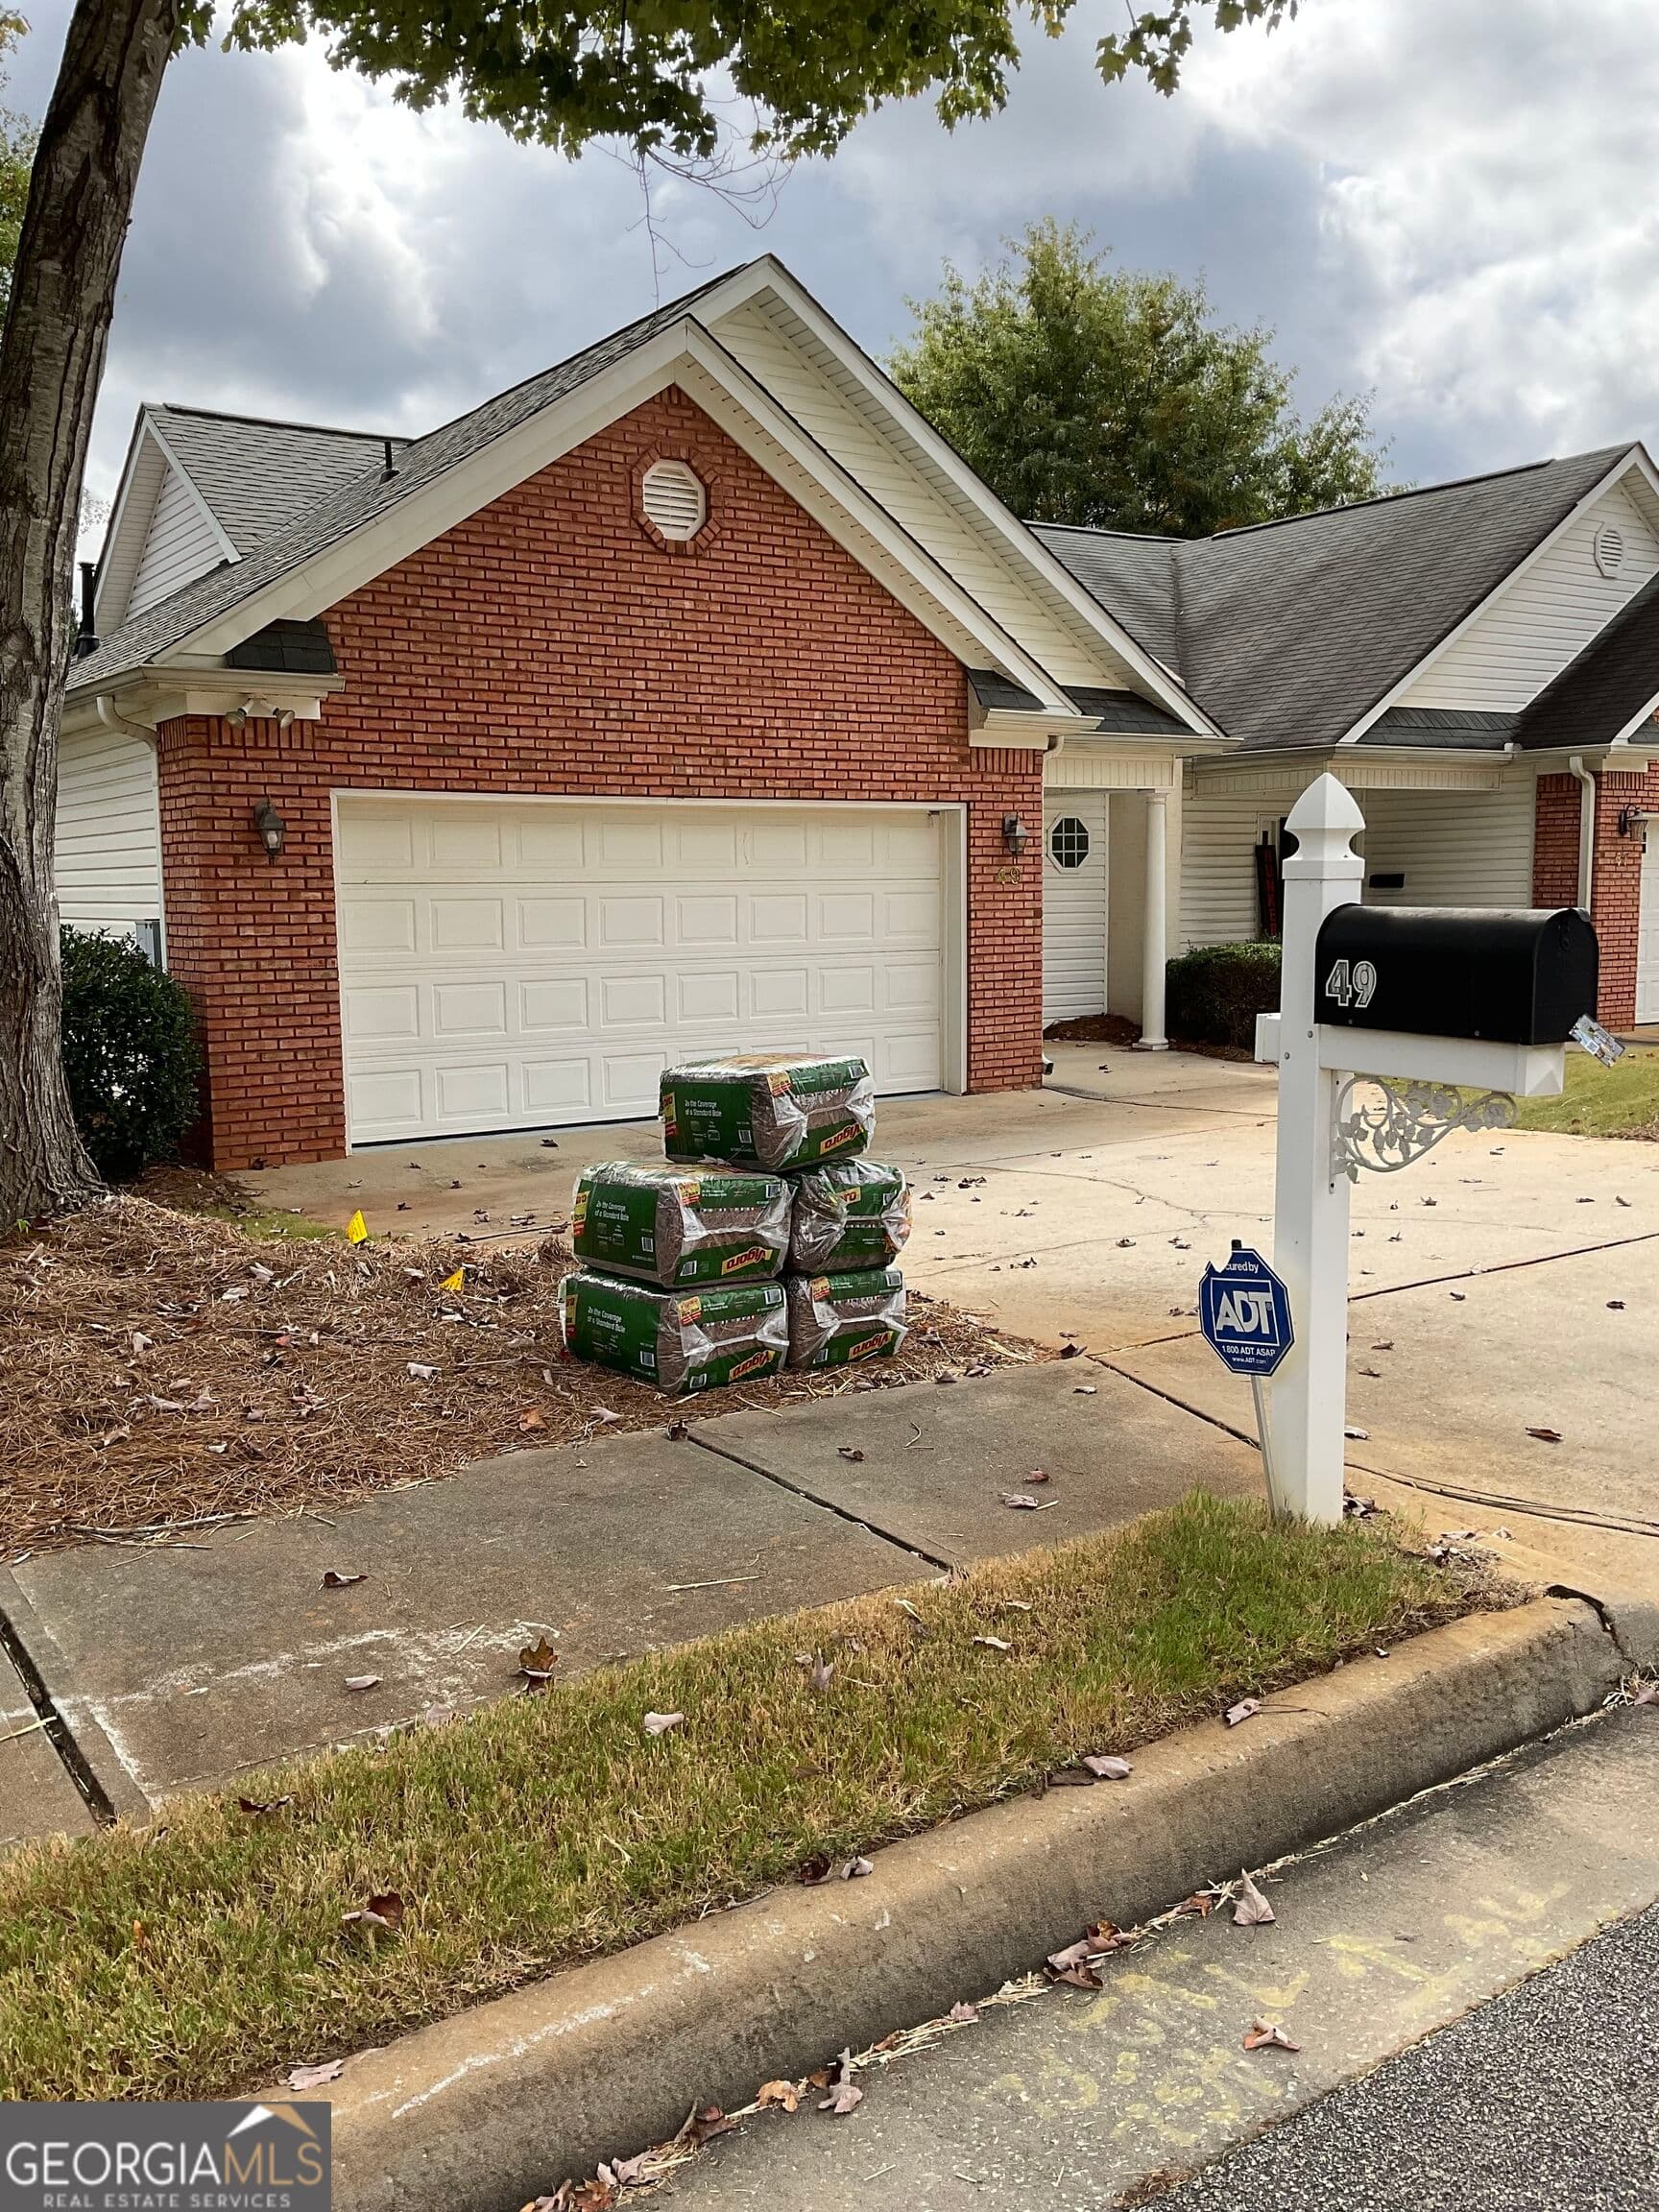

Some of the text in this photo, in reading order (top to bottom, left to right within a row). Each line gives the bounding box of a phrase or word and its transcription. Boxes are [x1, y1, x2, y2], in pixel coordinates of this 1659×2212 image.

[1325, 958, 1378, 1008] 49
[824, 1123, 862, 1149] Vigoro
[726, 1247, 767, 1270] Vigoro
[1225, 1261, 1260, 1274] cured by
[1215, 1289, 1273, 1334] ADT
[852, 1331, 890, 1357] Vigoro
[733, 1350, 770, 1378] Vigoro
